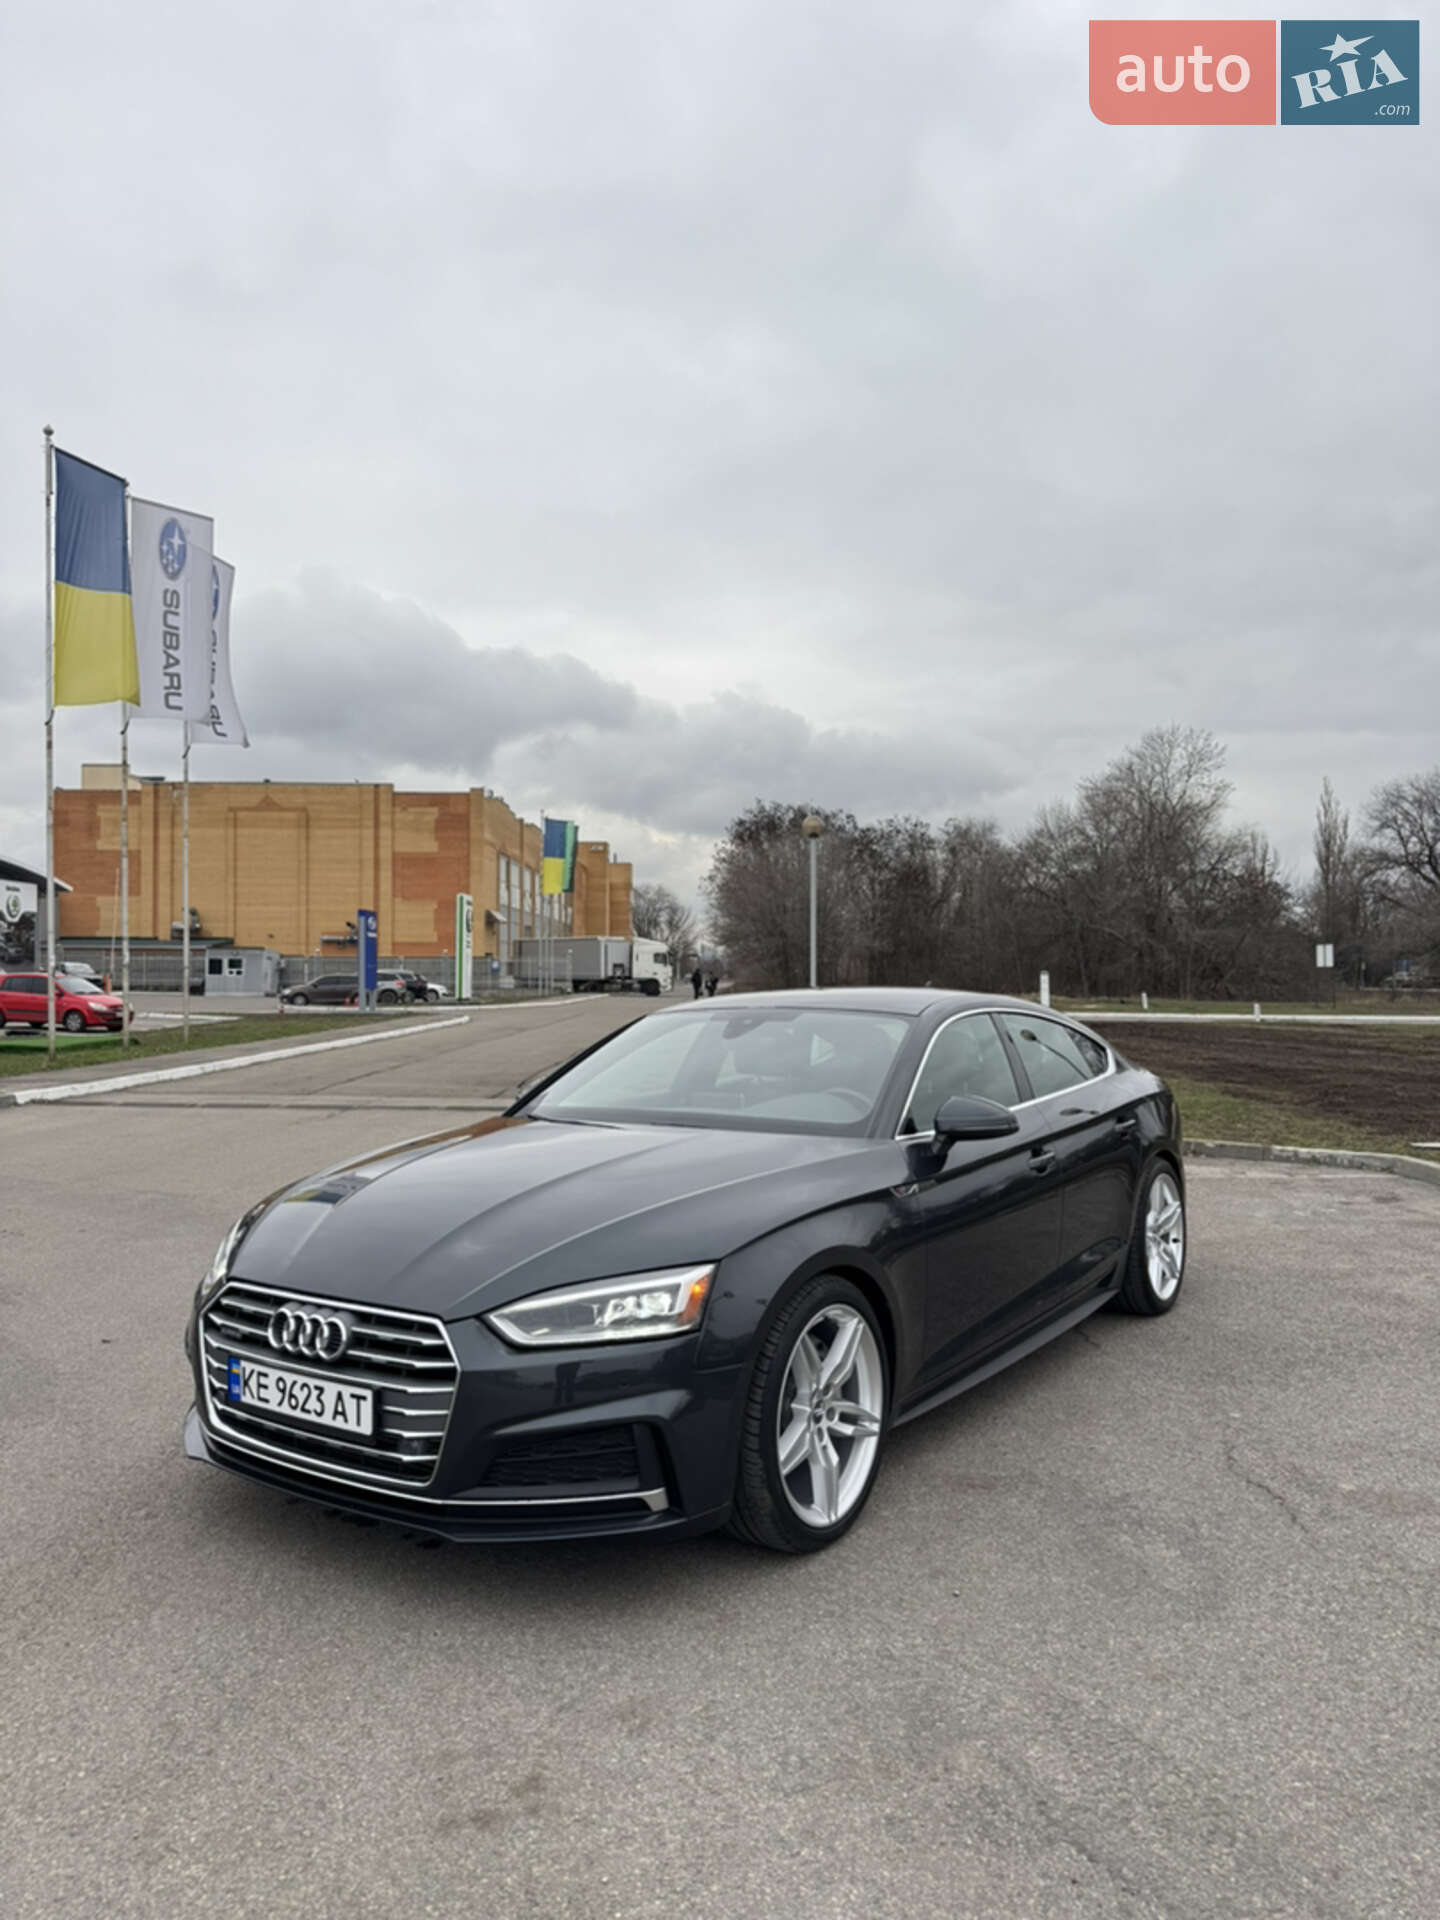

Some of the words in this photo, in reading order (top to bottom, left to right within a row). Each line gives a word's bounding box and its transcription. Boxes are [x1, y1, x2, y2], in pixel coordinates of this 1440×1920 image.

[162, 588, 183, 711] SUBARU
[242, 1366, 270, 1404] KE
[275, 1376, 326, 1418] 9623
[332, 1391, 368, 1427] AT
